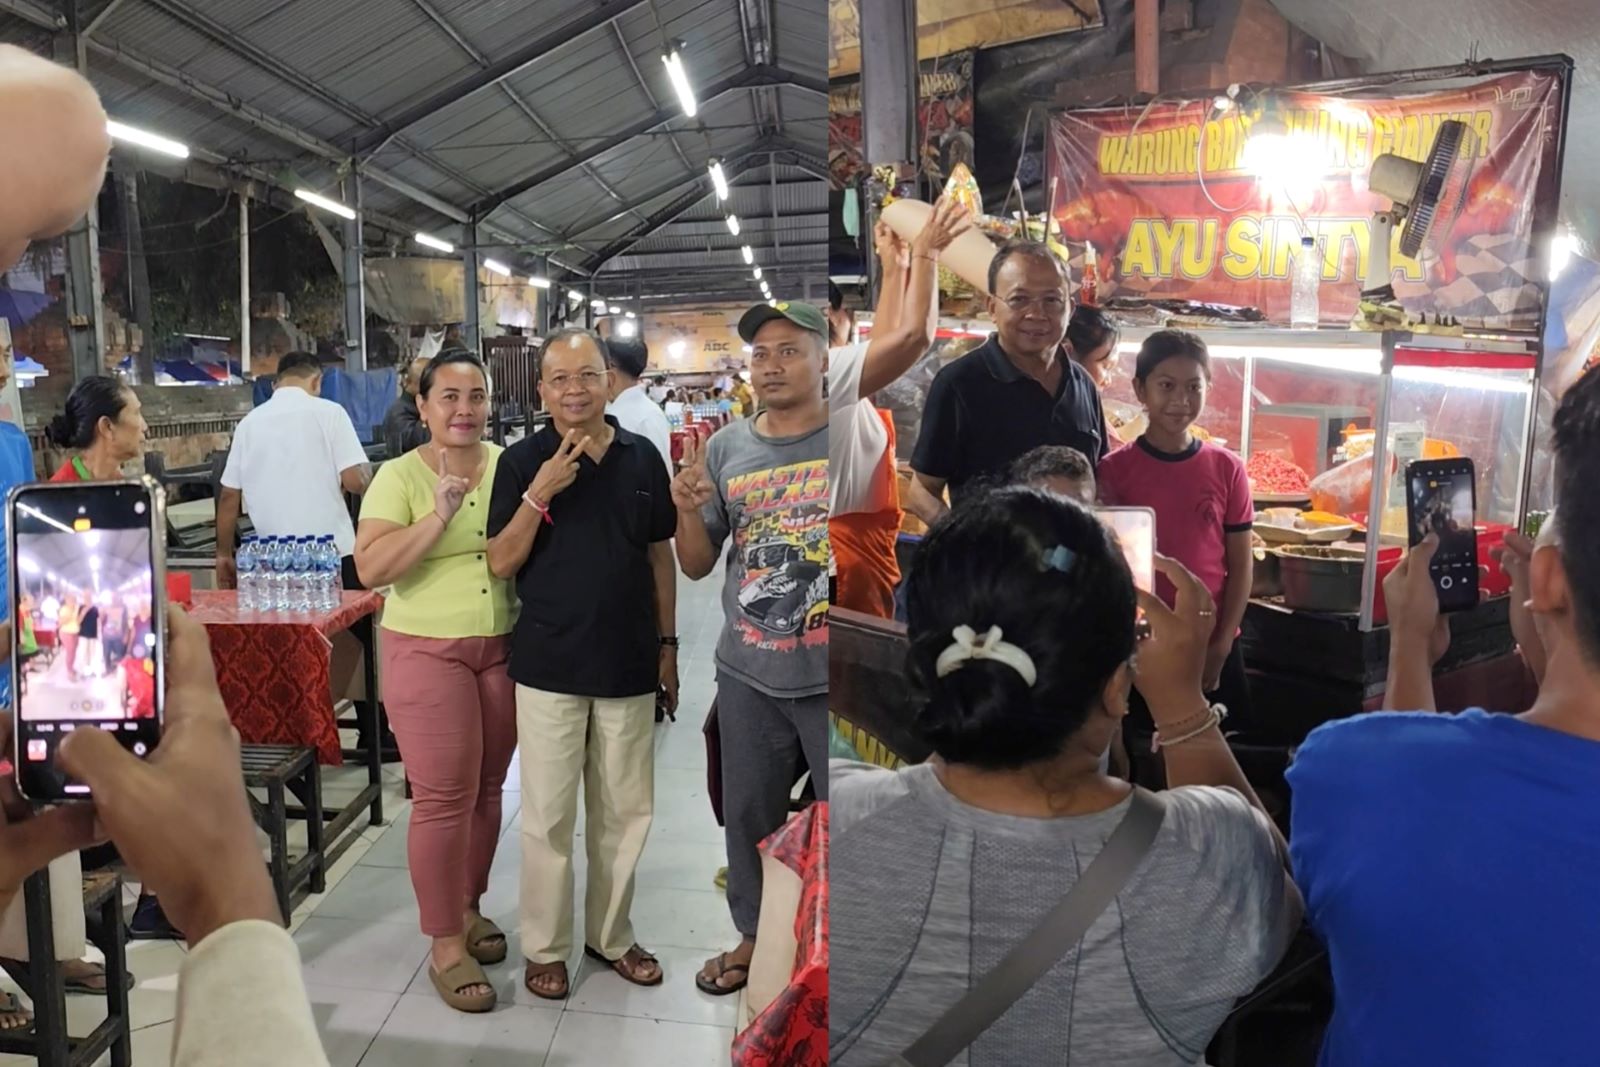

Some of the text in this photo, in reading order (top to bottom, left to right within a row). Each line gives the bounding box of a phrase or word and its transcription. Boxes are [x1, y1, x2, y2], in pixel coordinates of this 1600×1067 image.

[1100, 123, 1200, 174] WARUNG
[1121, 217, 1218, 278] AYU
[744, 478, 829, 512] SLAS
